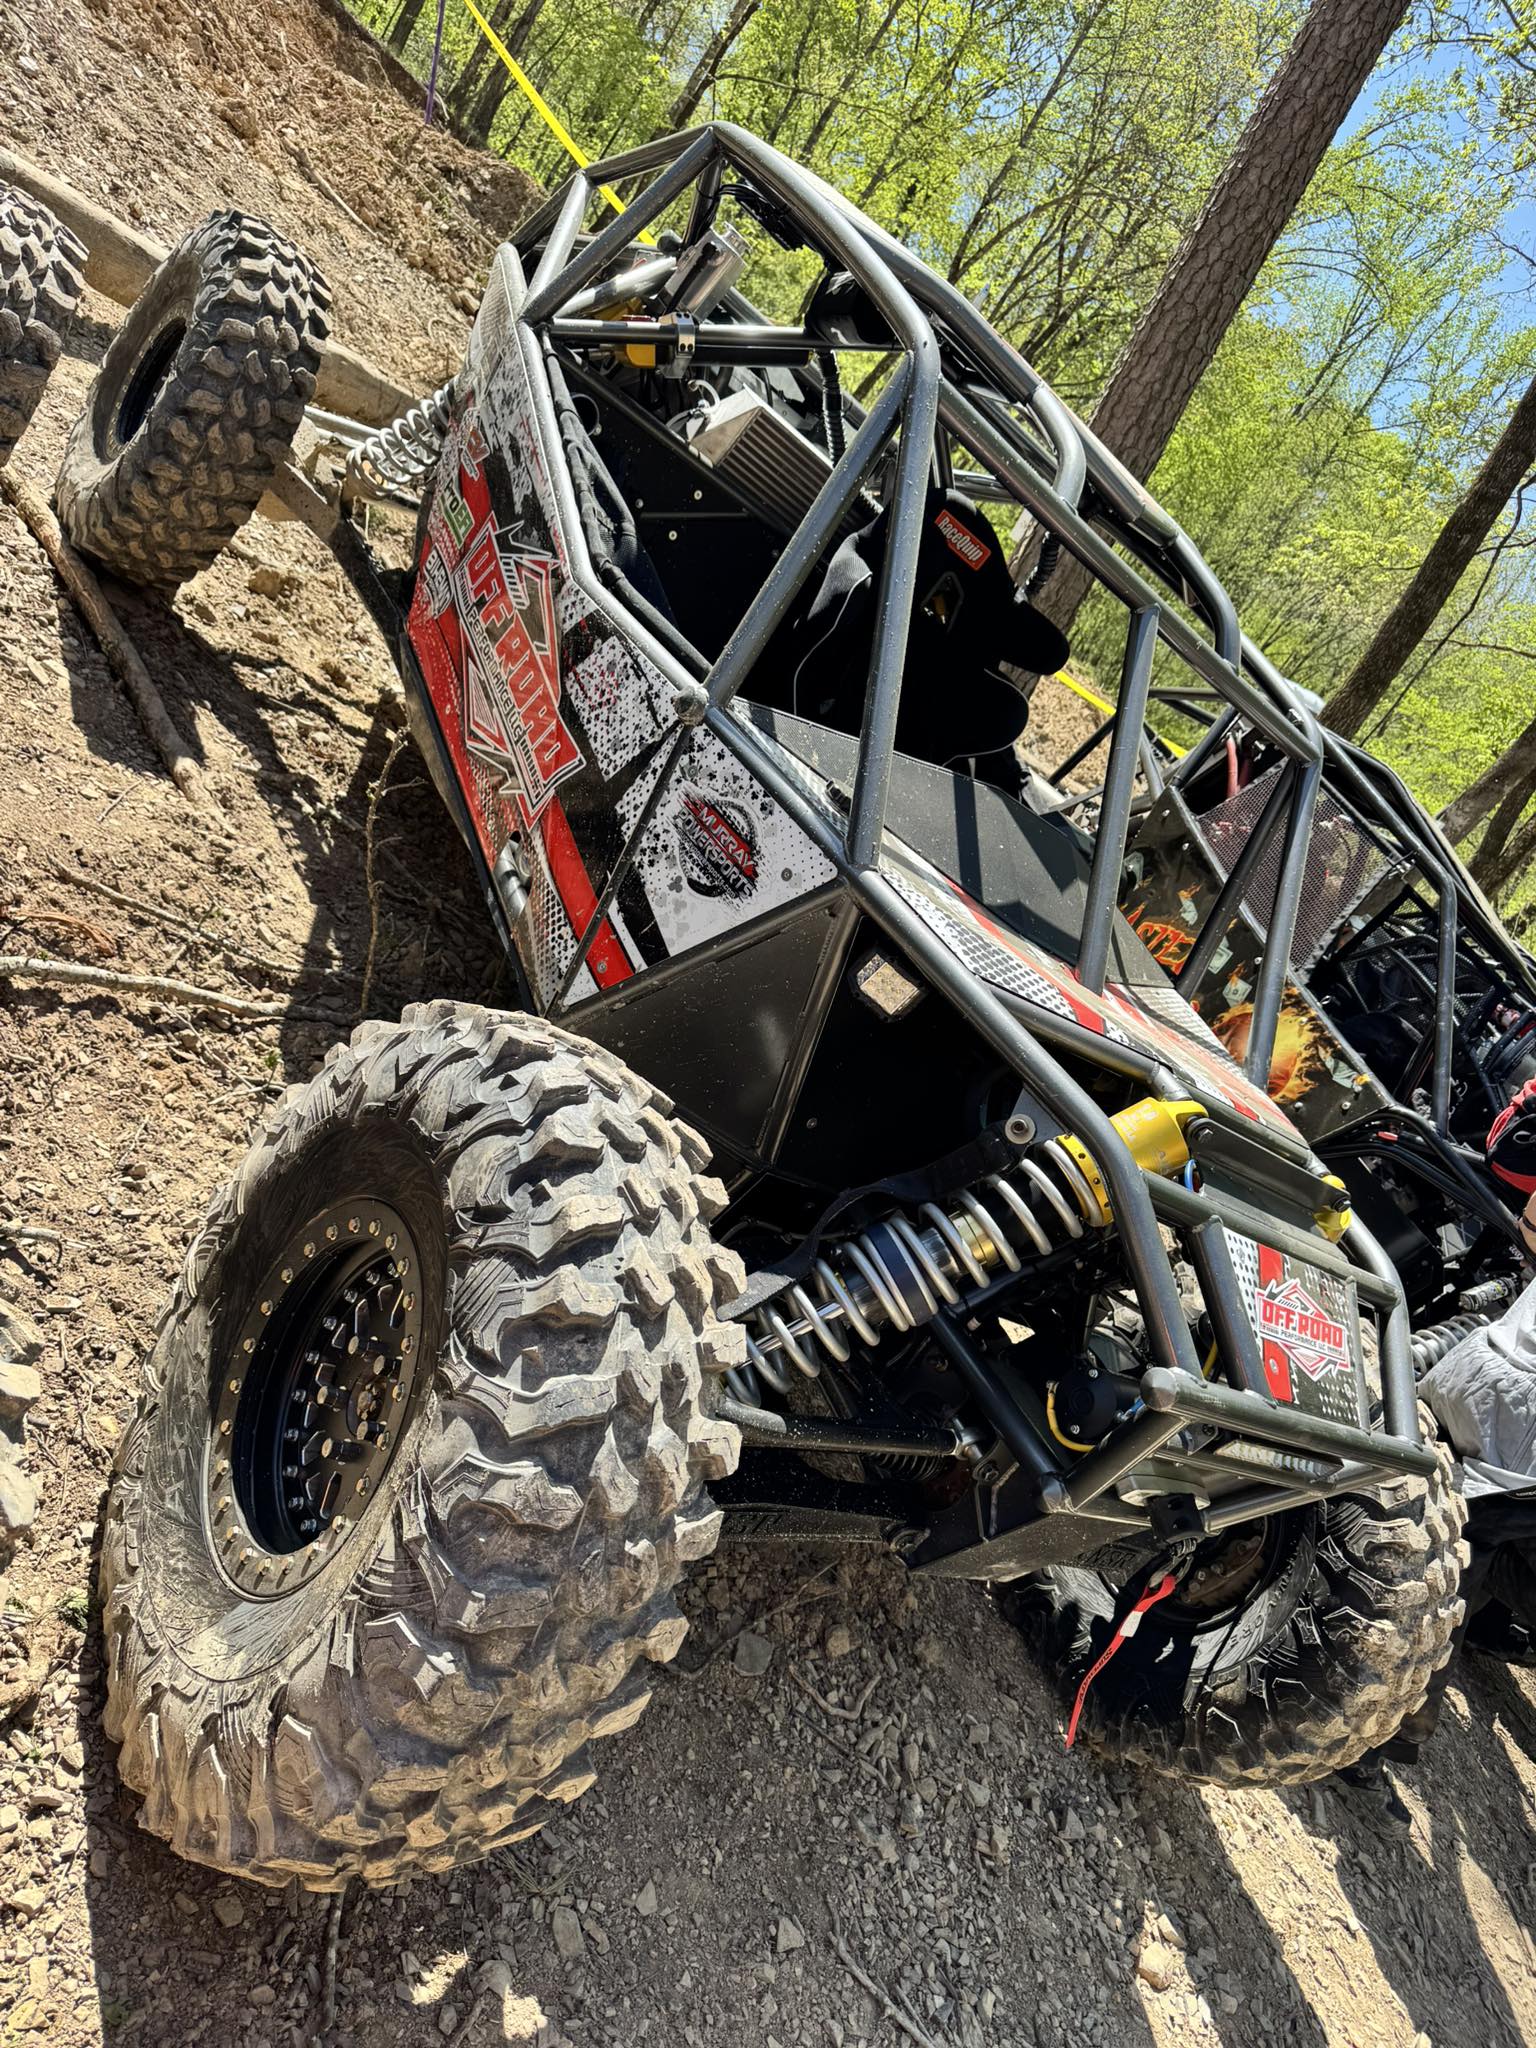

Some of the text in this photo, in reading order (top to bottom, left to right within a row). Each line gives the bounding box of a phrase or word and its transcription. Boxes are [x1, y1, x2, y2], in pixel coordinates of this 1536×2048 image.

[938, 516, 983, 561] RaceQuip
[465, 531, 513, 628] OFF
[495, 613, 580, 784] ROAD
[467, 605, 526, 743] PERFORMANCE LLC
[680, 808, 754, 899] POWERSPORTS
[700, 806, 754, 869] MURRAY
[1262, 1300, 1343, 1349] OFF ROAD
